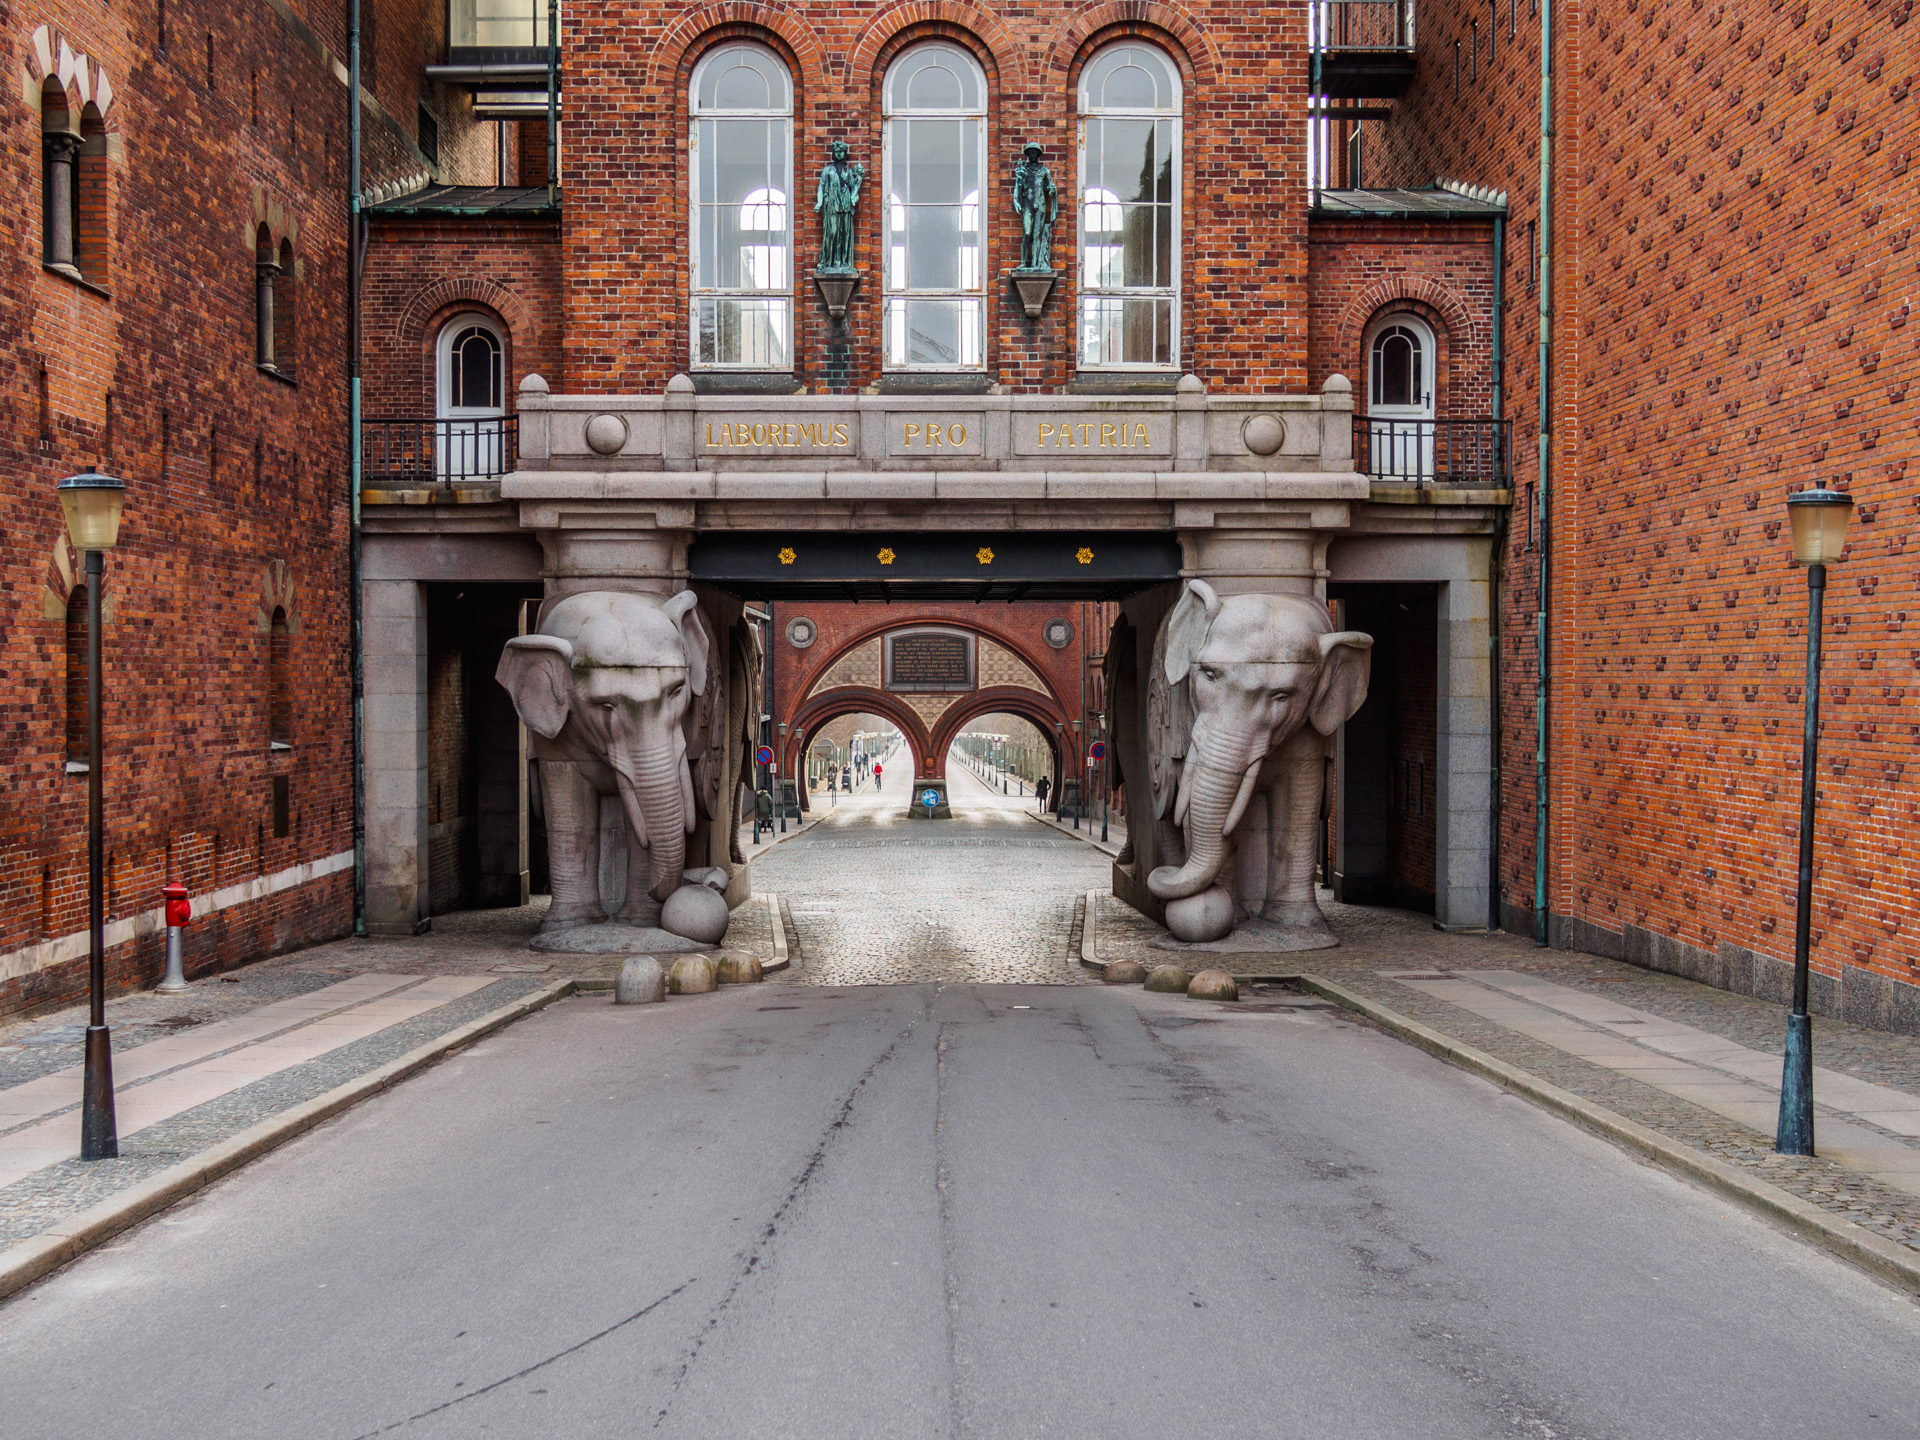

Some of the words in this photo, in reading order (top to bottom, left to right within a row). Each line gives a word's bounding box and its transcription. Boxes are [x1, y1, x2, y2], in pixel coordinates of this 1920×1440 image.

[706, 423, 849, 447] LABOREMUS
[904, 423, 967, 447] PRO
[1038, 423, 1151, 447] PATRIA
